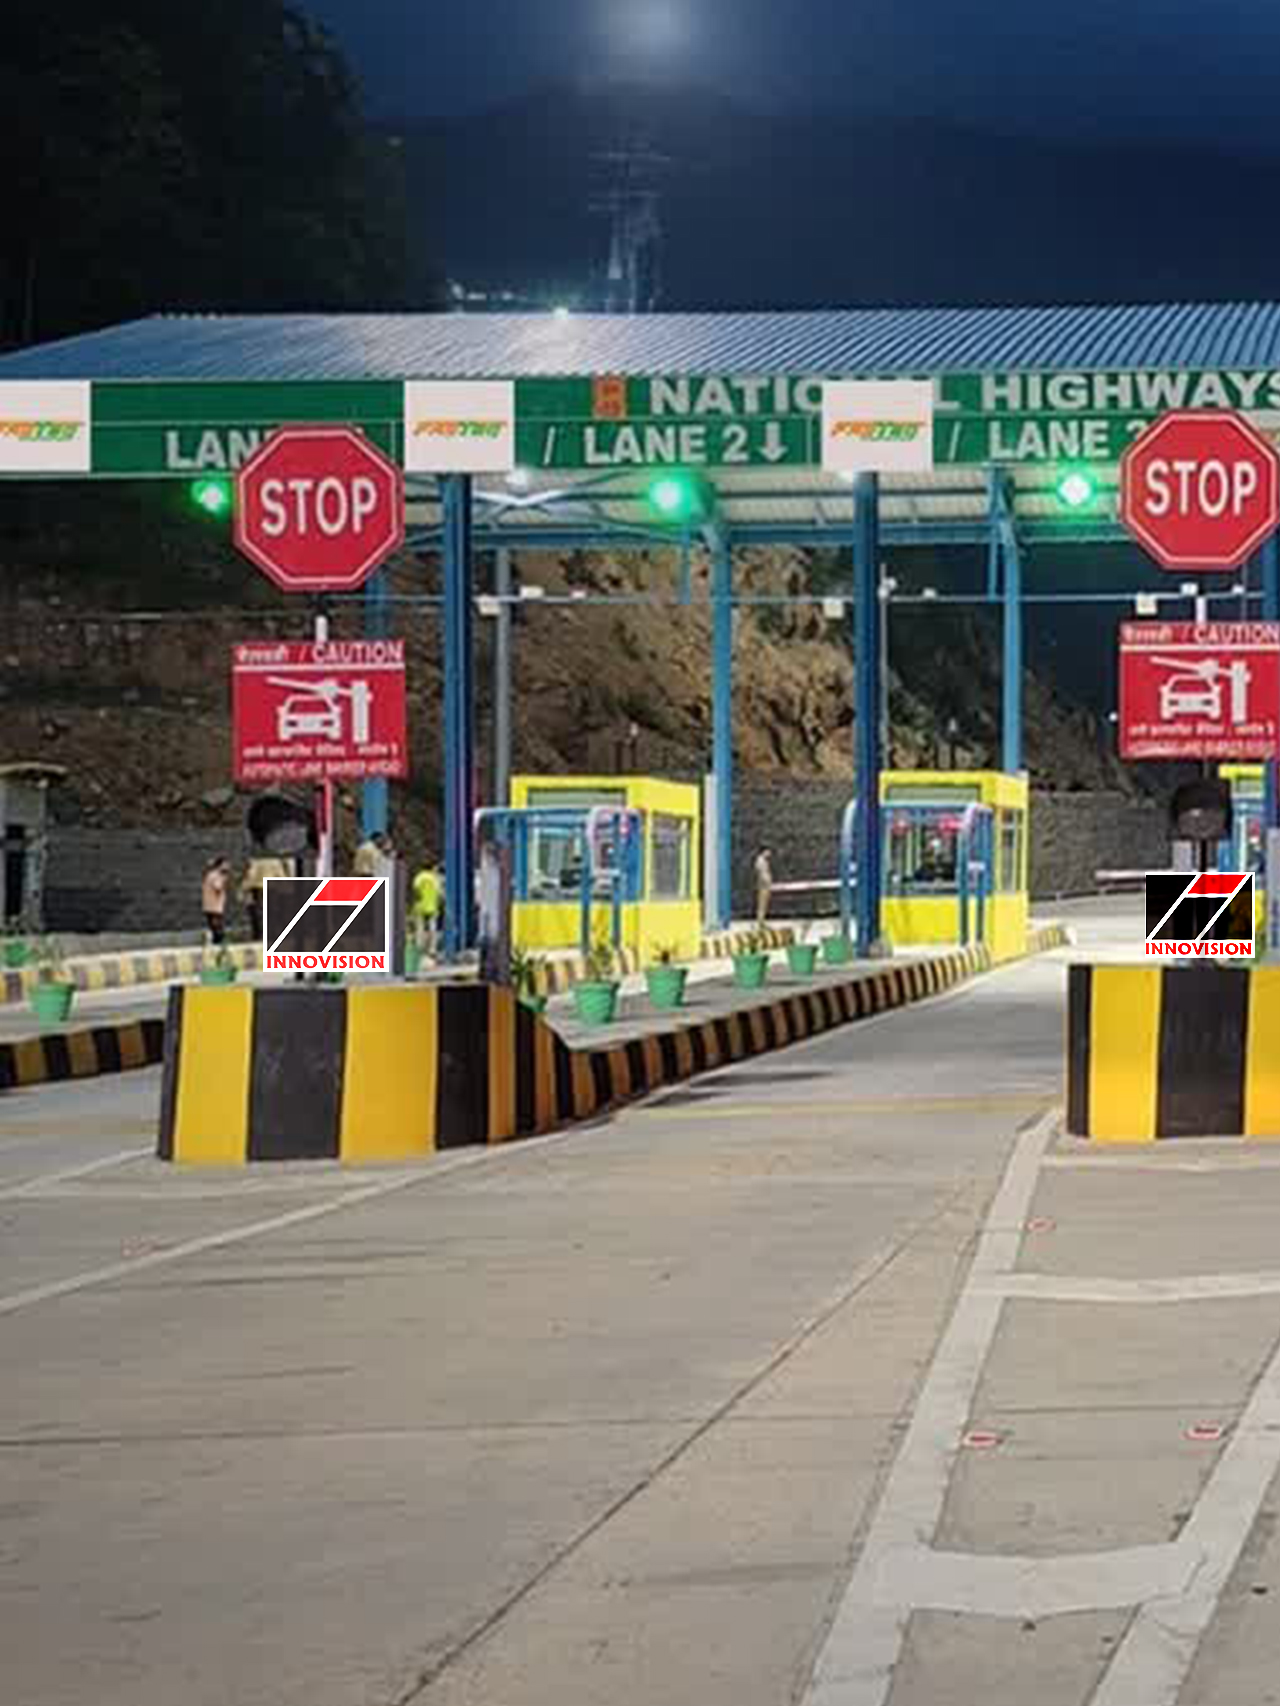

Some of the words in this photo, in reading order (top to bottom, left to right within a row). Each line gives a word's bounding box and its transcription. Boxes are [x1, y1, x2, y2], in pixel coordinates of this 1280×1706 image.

[651, 376, 960, 415] NATIOL
[166, 429, 275, 469] LAN
[584, 425, 707, 465] LANE
[722, 424, 750, 464] 2
[988, 420, 1110, 460] LANE
[260, 476, 378, 536] STOP
[1144, 458, 1257, 517] STOP
[312, 641, 403, 663] CAUTION
[1194, 622, 1280, 643] CAUTION
